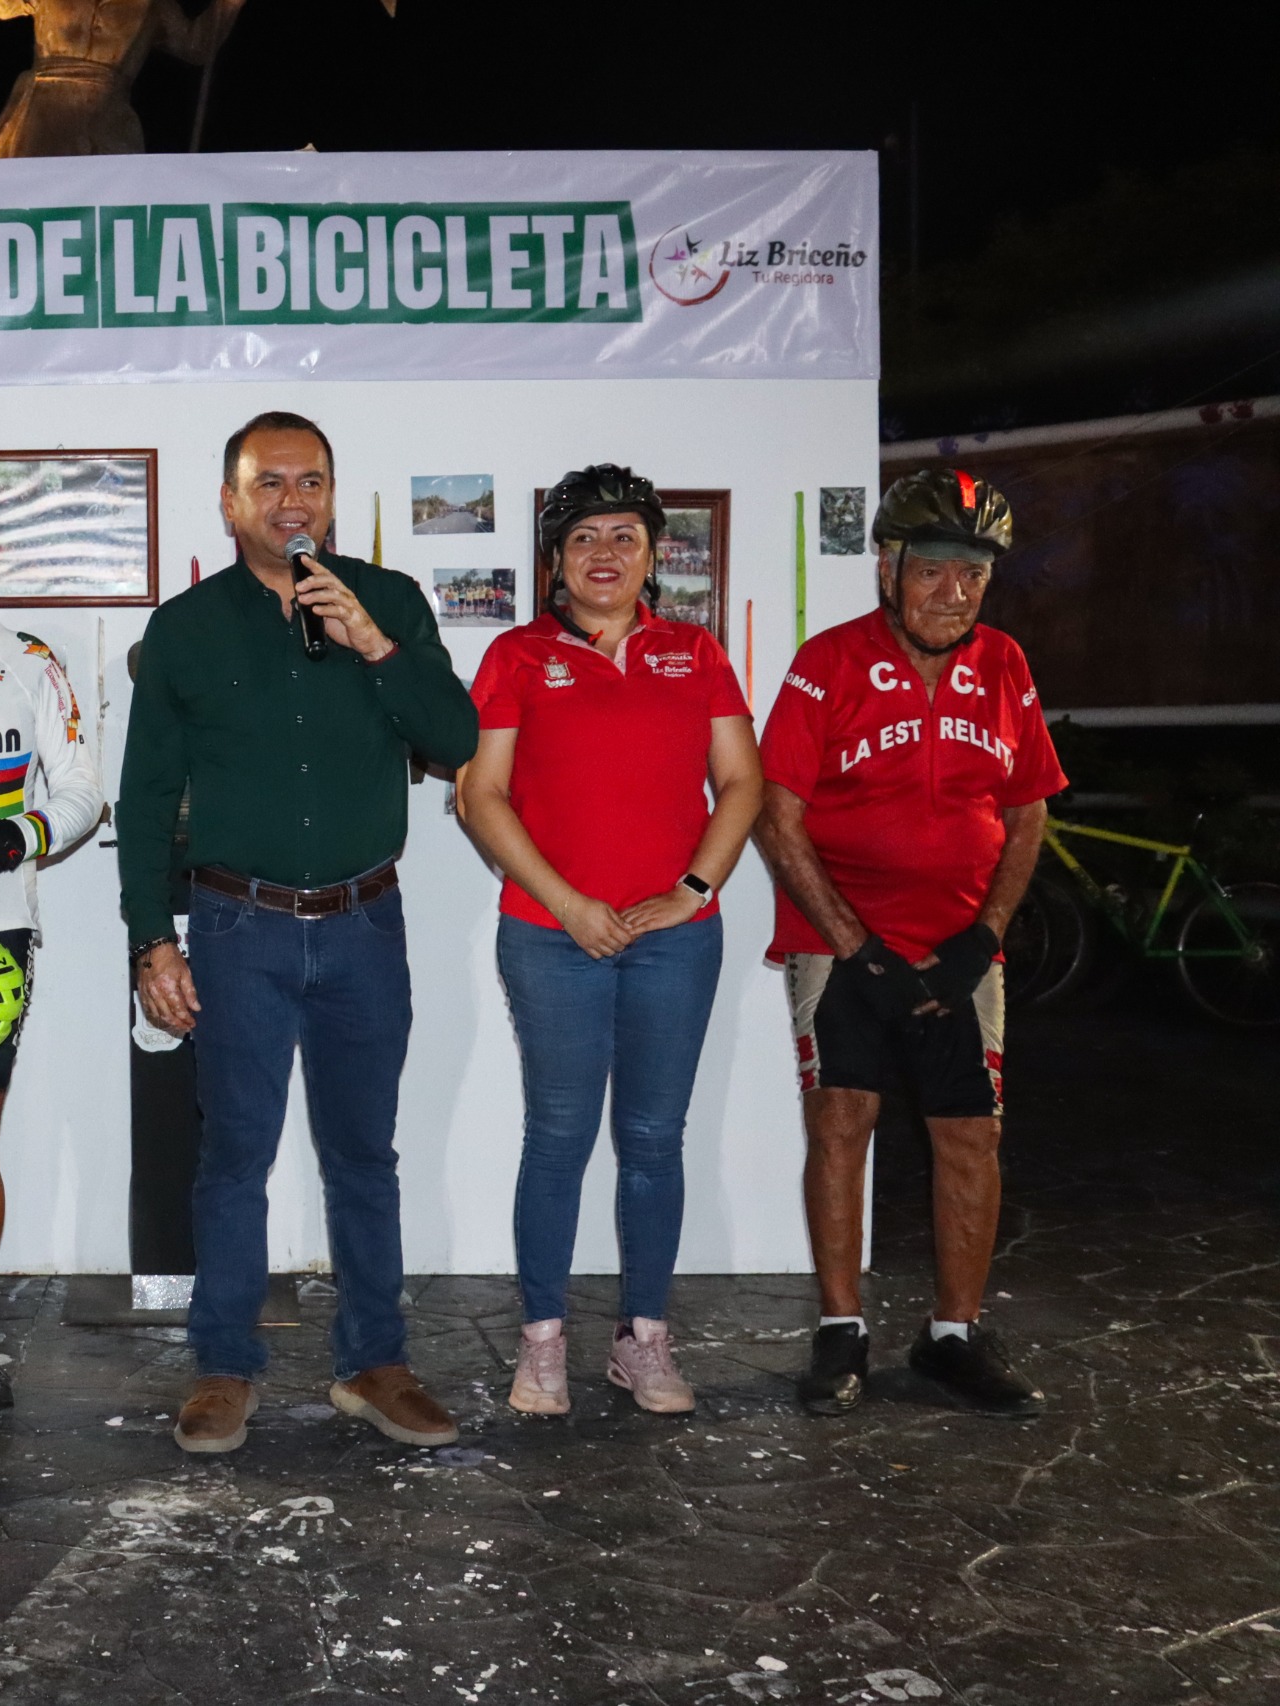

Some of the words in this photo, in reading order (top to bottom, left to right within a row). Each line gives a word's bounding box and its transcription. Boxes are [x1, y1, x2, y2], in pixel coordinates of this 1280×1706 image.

[112, 215, 212, 316] LA
[239, 212, 629, 313] BICICLETA
[719, 240, 760, 267] Liz
[767, 240, 868, 267] Briceño
[752, 271, 770, 284] Tu
[774, 270, 834, 286] Regidora
[869, 661, 911, 691] C.
[950, 665, 986, 696] C.
[841, 738, 871, 773] LA
